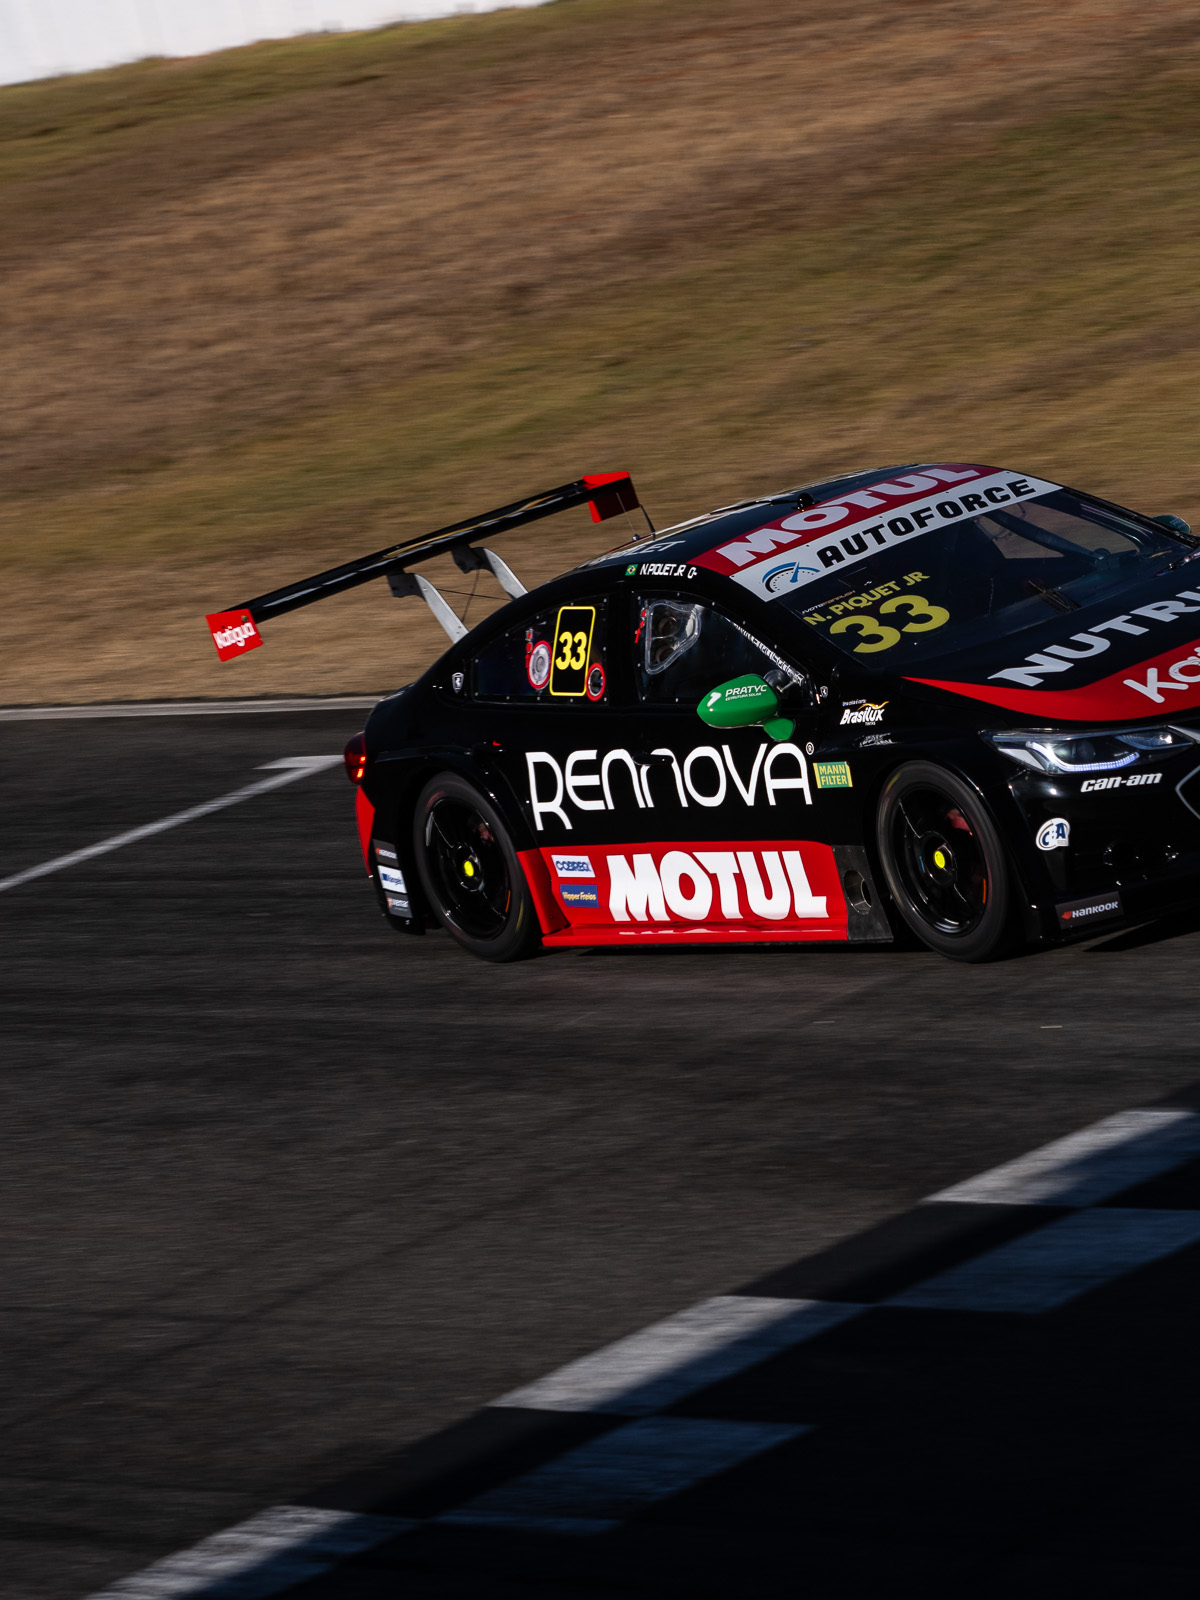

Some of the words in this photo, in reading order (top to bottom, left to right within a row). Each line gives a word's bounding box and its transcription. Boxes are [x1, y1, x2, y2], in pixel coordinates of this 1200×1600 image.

[715, 469, 981, 567] MOTUL
[816, 479, 1036, 568] AUTOFORCE
[829, 580, 901, 615] PIQUET
[902, 571, 931, 586] JR
[829, 594, 951, 653] 33
[555, 631, 588, 671] 33
[725, 685, 768, 697] PRATYC
[840, 707, 885, 726] Brasilux
[818, 764, 846, 775] MANN
[821, 775, 848, 786] FILTER
[1080, 773, 1163, 793] can-am
[606, 850, 830, 922] MOTUL
